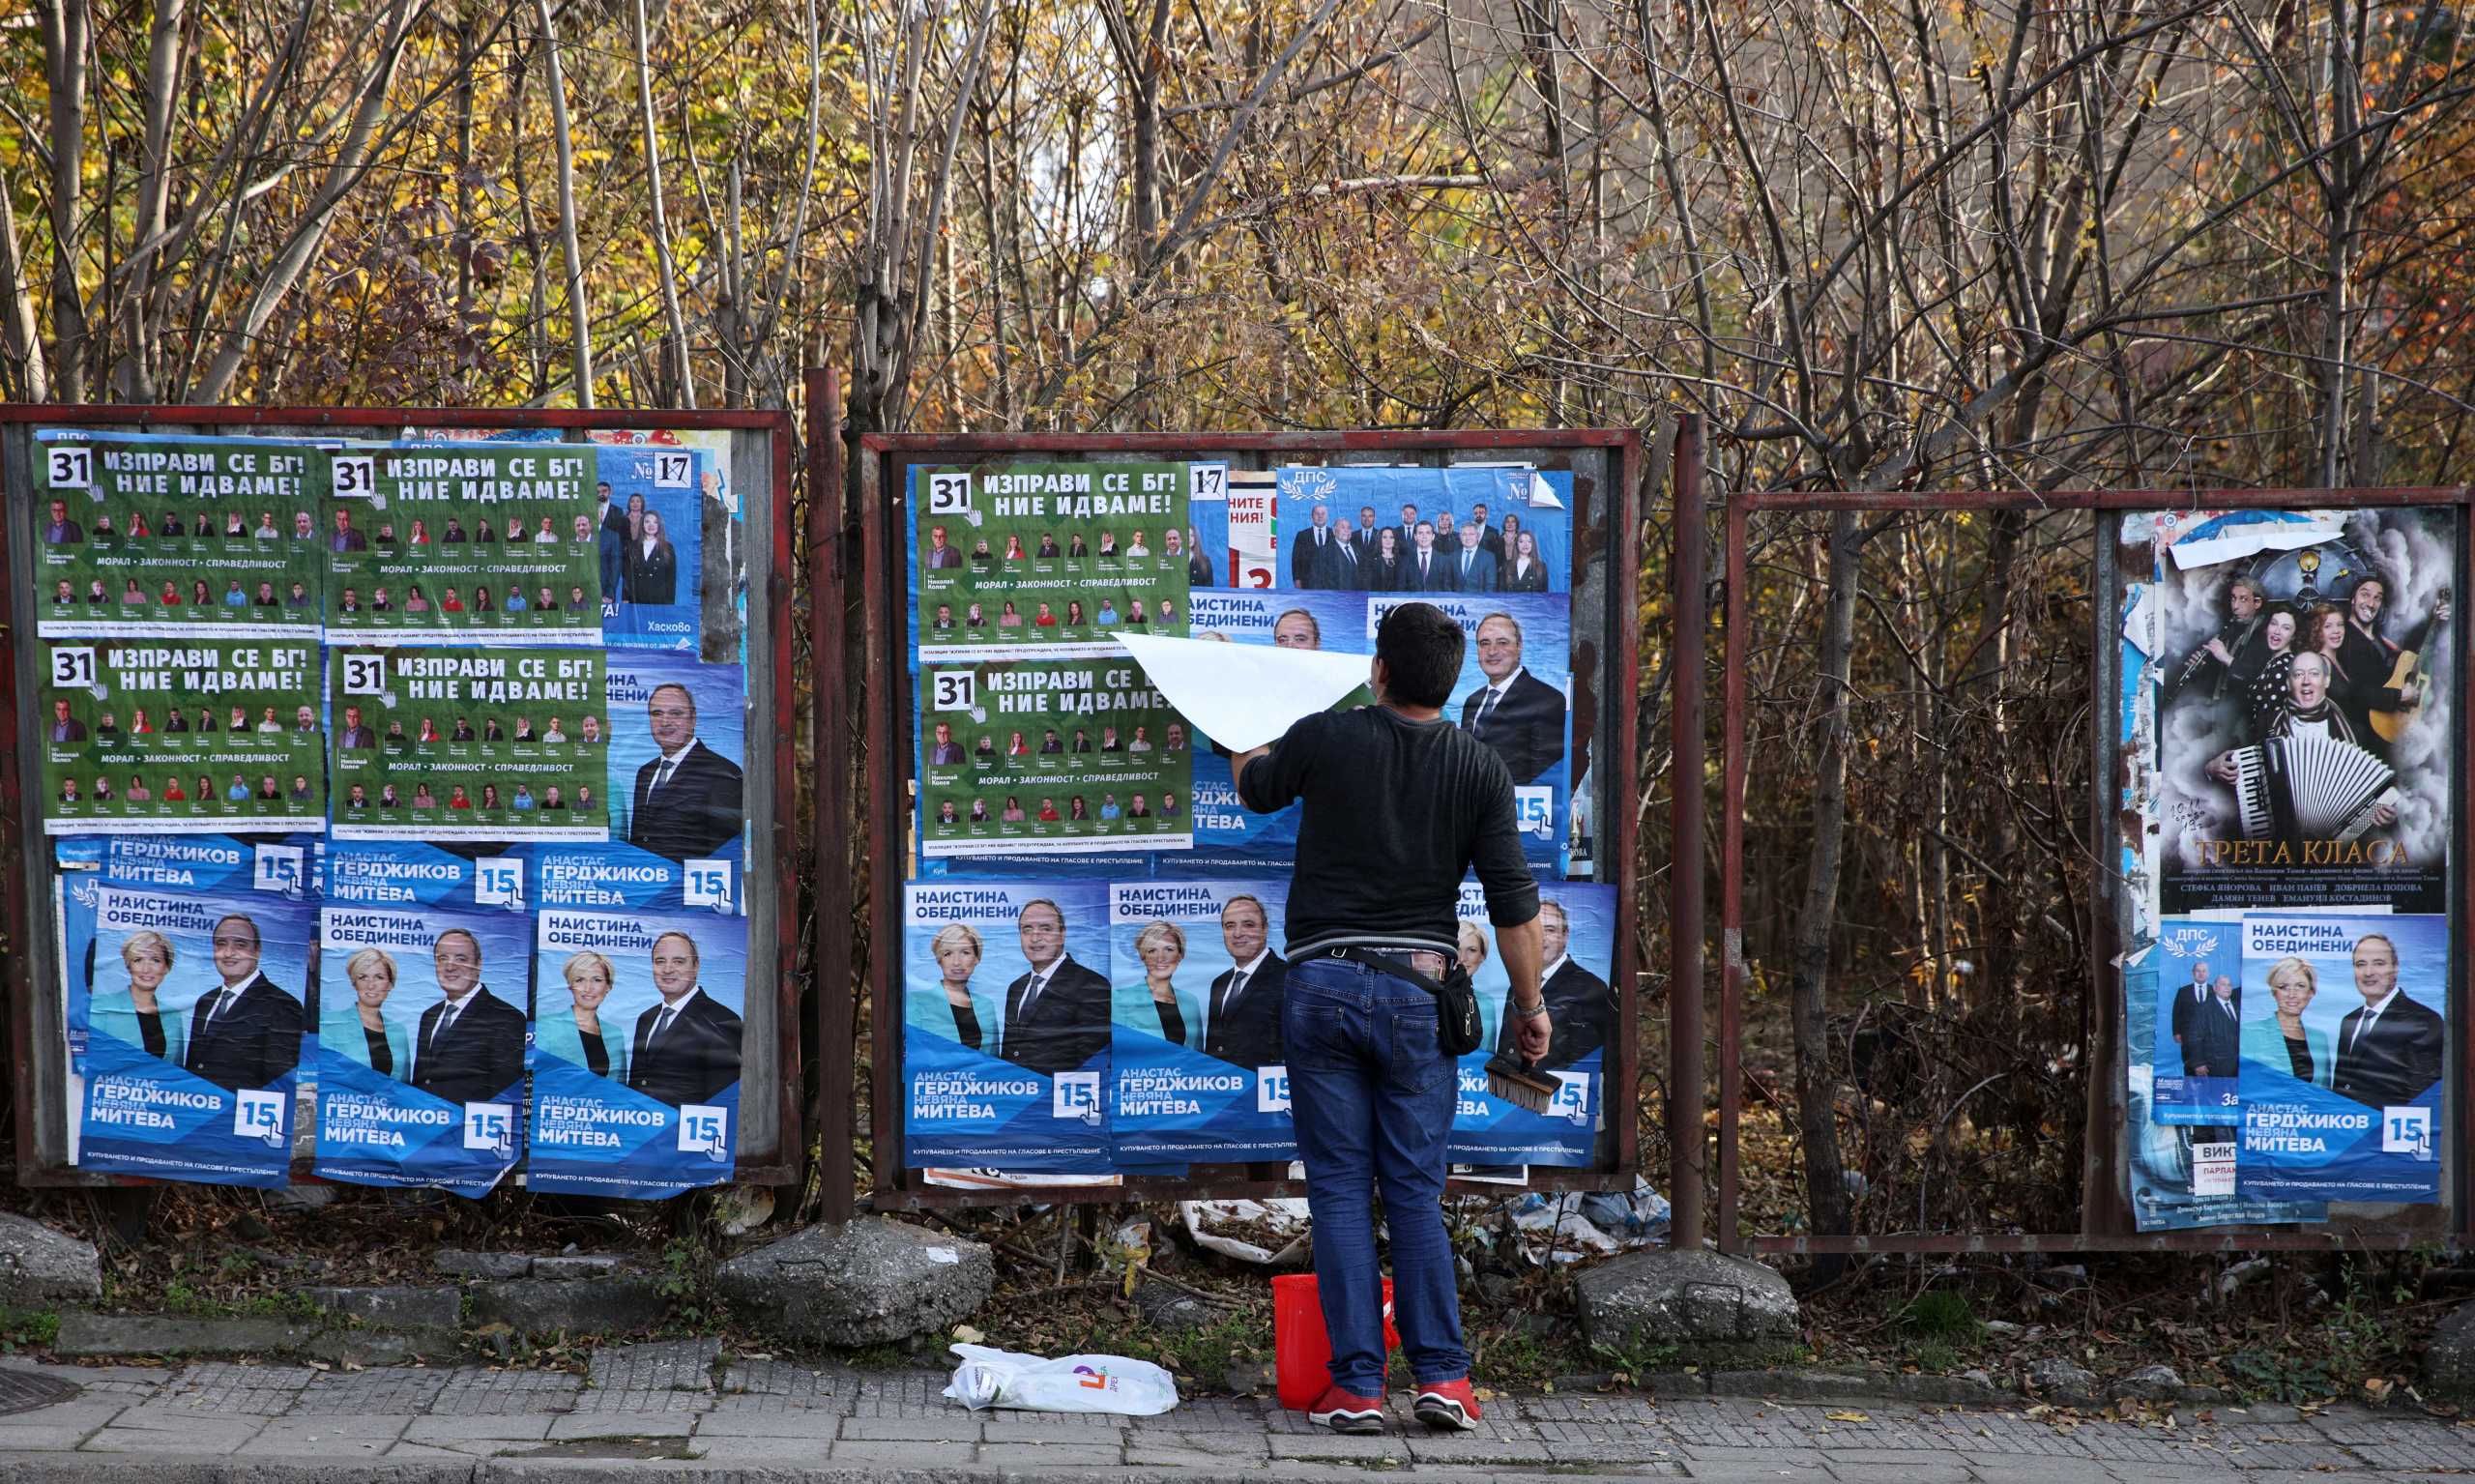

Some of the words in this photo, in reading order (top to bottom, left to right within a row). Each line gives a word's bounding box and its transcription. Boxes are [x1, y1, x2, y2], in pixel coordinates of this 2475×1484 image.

[52, 452, 89, 481] 31
[104, 452, 215, 472] ИЗПРАВИ
[228, 453, 256, 472] СЕ
[270, 455, 305, 474] БГ!
[387, 459, 495, 478] ИЗПРАВИ
[509, 459, 536, 478] СЕ
[549, 459, 584, 478] БГ!
[658, 456, 687, 480] 17
[336, 461, 371, 491] 31
[984, 474, 1090, 493] ИЗПРАВИ
[1103, 473, 1129, 491] СЕ
[1144, 472, 1176, 490] БГ!
[1196, 470, 1221, 493] 17
[1294, 472, 1325, 484] ДПС
[117, 475, 167, 493] НИЕ
[181, 476, 301, 497] ИДВАМЕ!
[399, 480, 449, 500] НИЕ
[461, 480, 579, 504] ИДВАМЕ!
[934, 480, 968, 508] 31
[995, 497, 1044, 516] НИЕ
[1057, 495, 1172, 518] ИДВАМЕ!
[97, 557, 131, 567] МОРАЛ
[139, 558, 196, 567] ЗАКОННОСТ
[206, 559, 286, 569] СПРАВЕДЛИВОСТ
[380, 565, 412, 573] МОРАЛ
[422, 565, 478, 574] ЗАКОННОСТ
[487, 564, 567, 574] СПРАВЕДЛИВОСТ
[975, 580, 1007, 589] МОРАЛ
[1016, 579, 1071, 589] ЗАКОННОСТ
[1080, 578, 1156, 589] СПРАВЕДЛИВОСТ
[648, 621, 690, 631] Хасково
[1189, 614, 1274, 628] БЕДИНЕНИ
[56, 653, 92, 681] 31
[108, 649, 218, 668] ИЗПРАВИ
[232, 649, 258, 668] СЕ
[272, 649, 306, 668] БГ!
[347, 660, 380, 688] 31
[397, 657, 505, 677] ИЗПРАВИ
[519, 658, 545, 678] СЕ
[558, 659, 592, 678] БГ!
[121, 671, 171, 690] НИЕ
[184, 671, 303, 694] ИДВАМЕ!
[988, 671, 1092, 690] ИЗПРАВИ
[1105, 669, 1131, 688] СЕ
[409, 679, 458, 698] НИЕ
[472, 681, 588, 703] ИДВАМЕ!
[938, 678, 972, 705] 31
[999, 692, 1047, 712] НИЕ
[102, 754, 134, 763] МОРАЛ
[143, 753, 200, 763] ЗАКОННОСТ
[210, 753, 289, 763] СПРАВЕДЛИВОСТ
[388, 762, 421, 771] МОРАЛ
[429, 763, 485, 771] ЗАКОННОСТ
[495, 763, 573, 773] СПРАВЕДЛИВОСТ
[978, 775, 1010, 784] МОРАЛ
[1019, 774, 1074, 784] ЗАКОННОСТ
[1083, 772, 1158, 783] СПРАВЕДЛИВОСТ
[1517, 797, 1545, 820] 15
[109, 842, 240, 863] ГЕРДЖИКОВ
[543, 856, 604, 865] АНАСТАС
[2193, 841, 2295, 864] ТРЕТА
[2303, 840, 2407, 864] КЛАСА
[109, 866, 193, 885] МИТЕВА
[262, 857, 294, 880] 15
[333, 861, 460, 880] ГЕРДЖИКОВ
[541, 865, 669, 883] ГЕРДЖИКОВ
[482, 869, 515, 892] 15
[542, 880, 595, 889] НЕВЯНА
[690, 871, 723, 894] 15
[334, 887, 415, 901] МИТЕВА
[541, 889, 625, 905] МИТЕВА
[917, 891, 1008, 904] НАИСТИНА
[1120, 887, 1210, 901] НАИСТИНА
[108, 896, 204, 915] НАИСТИНА
[917, 905, 1019, 919] ОБЕДИНЕНИ
[1120, 902, 1221, 917] ОБЕДИНЕНИ
[107, 912, 215, 931] ОБЕДИНЕНИ
[331, 915, 423, 931] НАИСТИНА
[549, 917, 642, 933] НАИСТИНА
[331, 929, 434, 946] ОБЕДИНЕНИ
[548, 931, 652, 948] ОБЕДИНЕНИ
[2176, 930, 2208, 943] ДПС
[2253, 925, 2343, 937] НАИСТИНА
[2253, 940, 2353, 953] ОБЕДИНЕНИ
[915, 1072, 975, 1082] АНАСТАС
[1121, 1068, 1180, 1078] АНАСТАС
[95, 1076, 158, 1088] АНАСТАС
[914, 1081, 1038, 1096] ГЕРДЖИКОВ
[1120, 1077, 1243, 1092] ГЕРДЖИКОВ
[93, 1084, 221, 1111] ГЕРДЖИКОВ
[328, 1094, 387, 1106] АНАСТАС
[541, 1095, 602, 1107] АНАСТАС
[915, 1094, 967, 1104] НЕВЯНА
[1061, 1083, 1092, 1106] 15
[1121, 1091, 1172, 1101] НЕВЯНА
[93, 1098, 147, 1111] НЕВЯНА
[914, 1104, 995, 1119] МИТЕВА
[1121, 1100, 1201, 1116] МИТЕВА
[2248, 1105, 2308, 1115] АНАСТАС
[91, 1108, 175, 1128] МИТЕВА
[244, 1101, 276, 1126] 15
[326, 1104, 450, 1124] ГЕРДЖИКОВ
[540, 1105, 664, 1126] ГЕРДЖИКОВ
[2246, 1114, 2369, 1129] ГЕРДЖИКОВ
[327, 1119, 377, 1129] НЕВЯНА
[472, 1114, 505, 1138] 15
[541, 1120, 592, 1131] НЕВЯНА
[688, 1117, 719, 1140] 15
[2247, 1127, 2298, 1138] НЕВЯНА
[2390, 1119, 2422, 1141] 15
[325, 1127, 405, 1146] МИТЕВА
[539, 1130, 621, 1148] МИТЕВА
[2246, 1137, 2326, 1151] МИТЕВА
[1453, 1145, 1497, 1153] ПРОДАВАНЕТО
